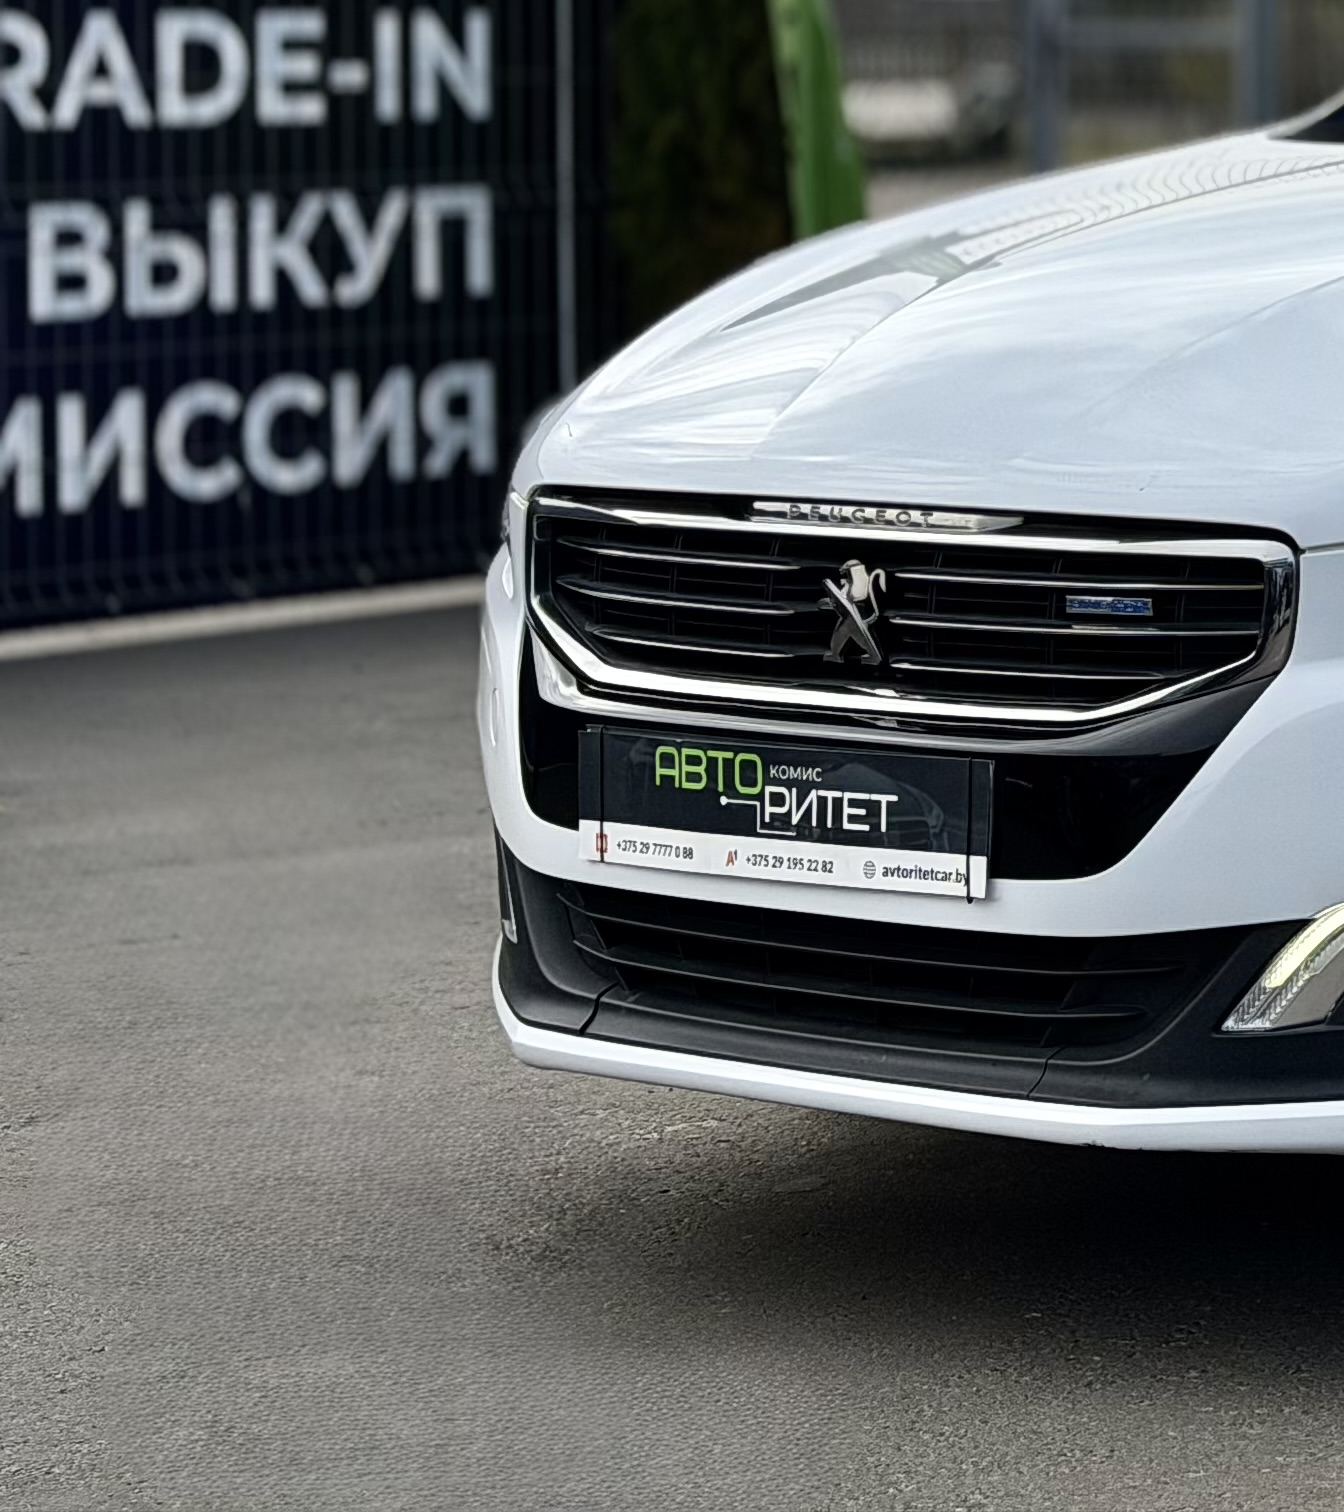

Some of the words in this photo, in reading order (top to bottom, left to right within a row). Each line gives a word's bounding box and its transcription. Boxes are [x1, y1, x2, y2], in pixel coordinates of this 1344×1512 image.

[27, 185, 493, 324] ВЫКУП
[786, 504, 935, 529] PEUGEOT
[655, 745, 763, 795] АВТО
[769, 764, 823, 782] КОМИС
[764, 785, 899, 833] РИТЕТ
[617, 840, 637, 853] +375
[639, 842, 650, 854] 29
[652, 843, 673, 857] 7777
[745, 854, 770, 867] +375
[771, 856, 784, 868] 29
[786, 857, 804, 870] 195
[807, 859, 819, 872] 22
[821, 860, 834, 873] 82
[881, 865, 968, 887] avtoritetcar.by
